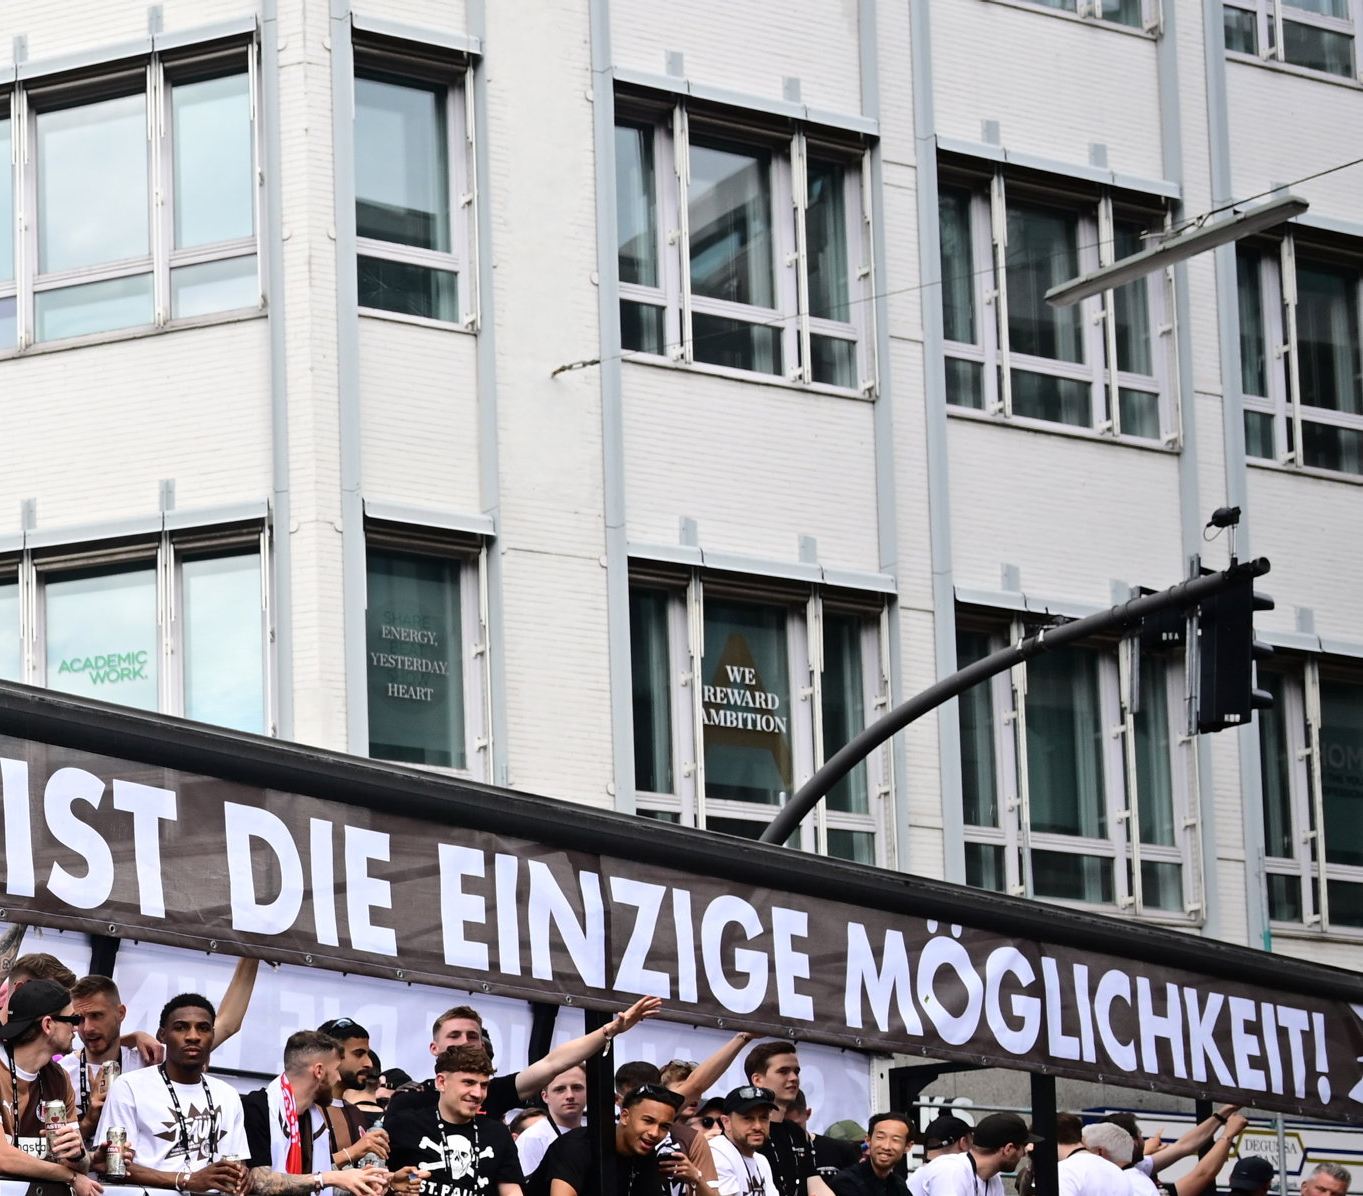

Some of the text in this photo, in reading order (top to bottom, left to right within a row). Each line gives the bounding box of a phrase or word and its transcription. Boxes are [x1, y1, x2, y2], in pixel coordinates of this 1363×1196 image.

[58, 650, 149, 674] ACADEMIC
[89, 666, 149, 685] WORK.
[725, 664, 757, 686] WE
[387, 682, 434, 702] HEART
[702, 684, 780, 711] REWARD
[701, 706, 787, 734] AMBITION
[0, 756, 178, 919] IST
[223, 800, 398, 958] DIE
[438, 842, 815, 1023] EINZIGE
[845, 918, 1334, 1106] MÖGLICHKEIT!
[419, 1180, 439, 1196] ST.
